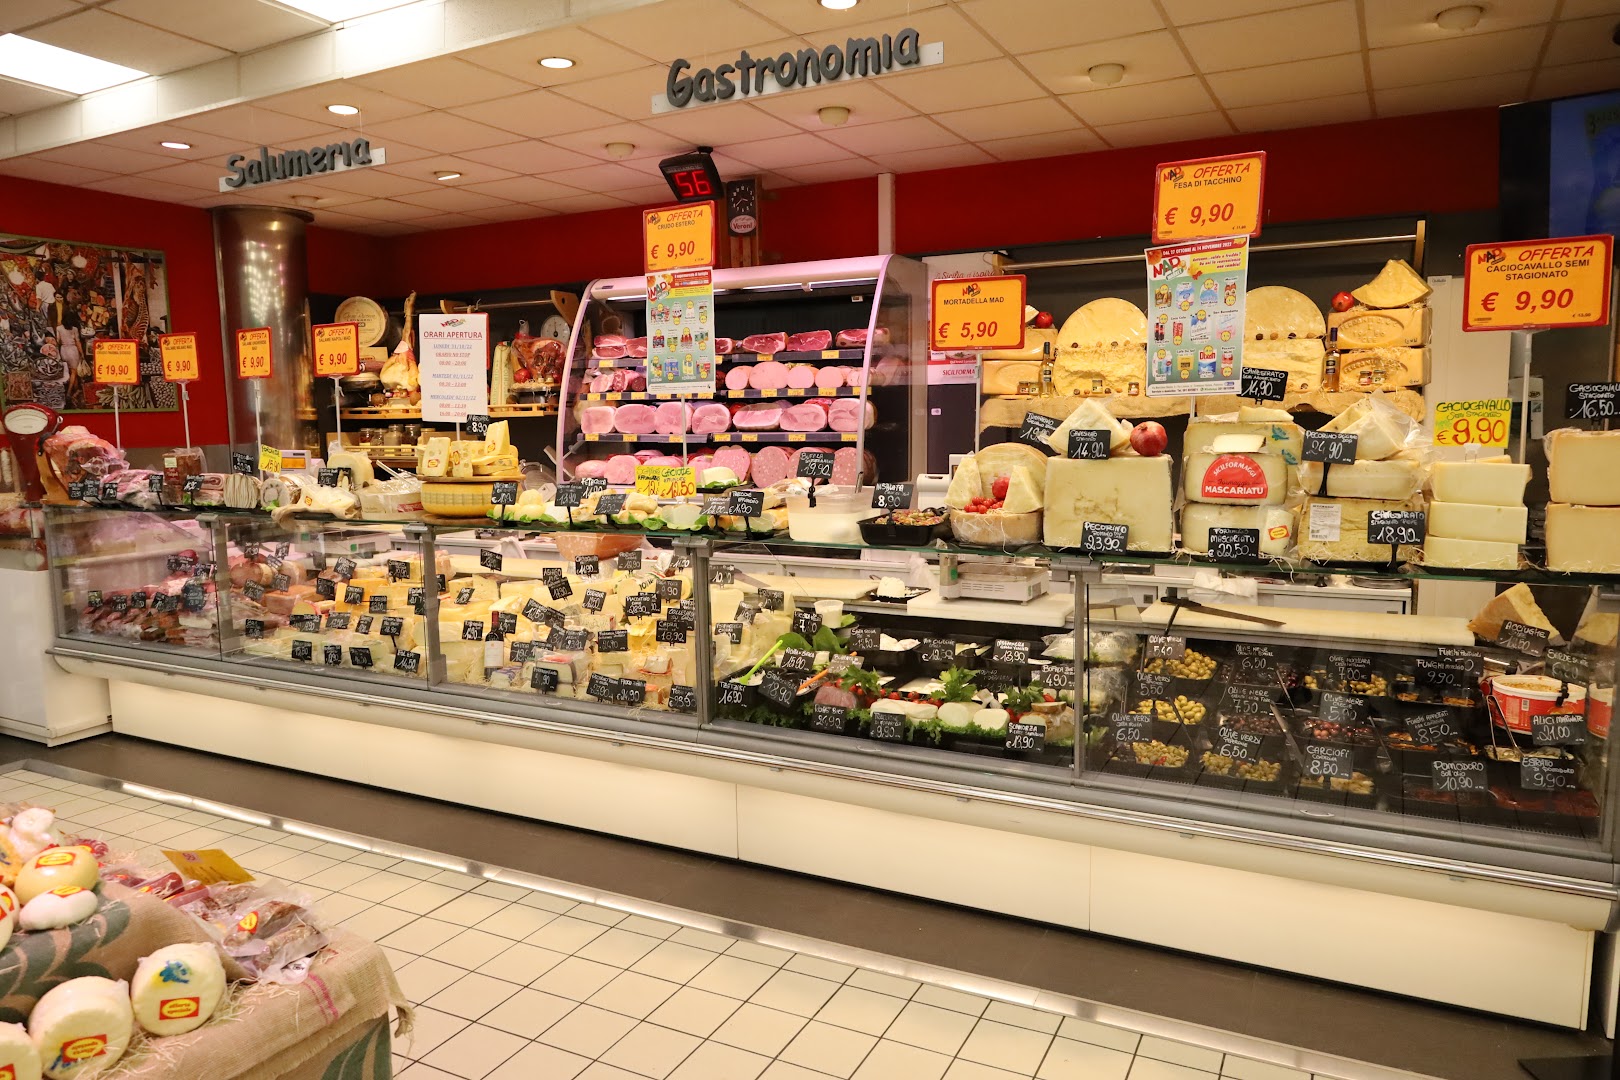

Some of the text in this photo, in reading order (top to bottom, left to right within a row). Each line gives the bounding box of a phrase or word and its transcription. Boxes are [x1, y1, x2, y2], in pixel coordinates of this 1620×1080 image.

[666, 28, 920, 107] Gastronomia
[225, 137, 372, 188] Salumeria
[1193, 163, 1251, 179] OFFERTA
[673, 169, 711, 197] 56
[1173, 181, 1193, 189] FESA
[1204, 176, 1242, 186] TACCHINO
[666, 209, 704, 222] OFFERTA
[1164, 202, 1235, 227] € 9,90
[650, 240, 695, 259] € 9,90
[1202, 242, 1222, 250] NOVEMBRE
[1518, 245, 1595, 262] OFFERTA
[1486, 259, 1590, 273] CACIOCAVALLO SEMI
[1505, 270, 1569, 281] STAGIONATO
[943, 296, 1005, 306] MORTADELLA MAD
[1481, 288, 1574, 314] € 9,90
[249, 332, 267, 340] OFFERTA
[328, 328, 352, 337] OFFERTA
[446, 331, 483, 339] APERTURA
[938, 321, 998, 341] € 5,90
[167, 360, 191, 373] € 9,90
[242, 356, 264, 370] € 9,90
[319, 353, 347, 367] € 9,90
[97, 364, 129, 376] € 19,90
[1436, 417, 1506, 445] € 9,90
[1213, 461, 1257, 478] SICILFORMAGGI
[1205, 485, 1264, 495] MASCARIATU
[1306, 745, 1350, 758] CARCIOFI
[1310, 760, 1338, 775] 8,50
[1433, 760, 1484, 771] POMODORO
[1439, 776, 1473, 791] 10,90
[1533, 772, 1566, 788] 9,90
